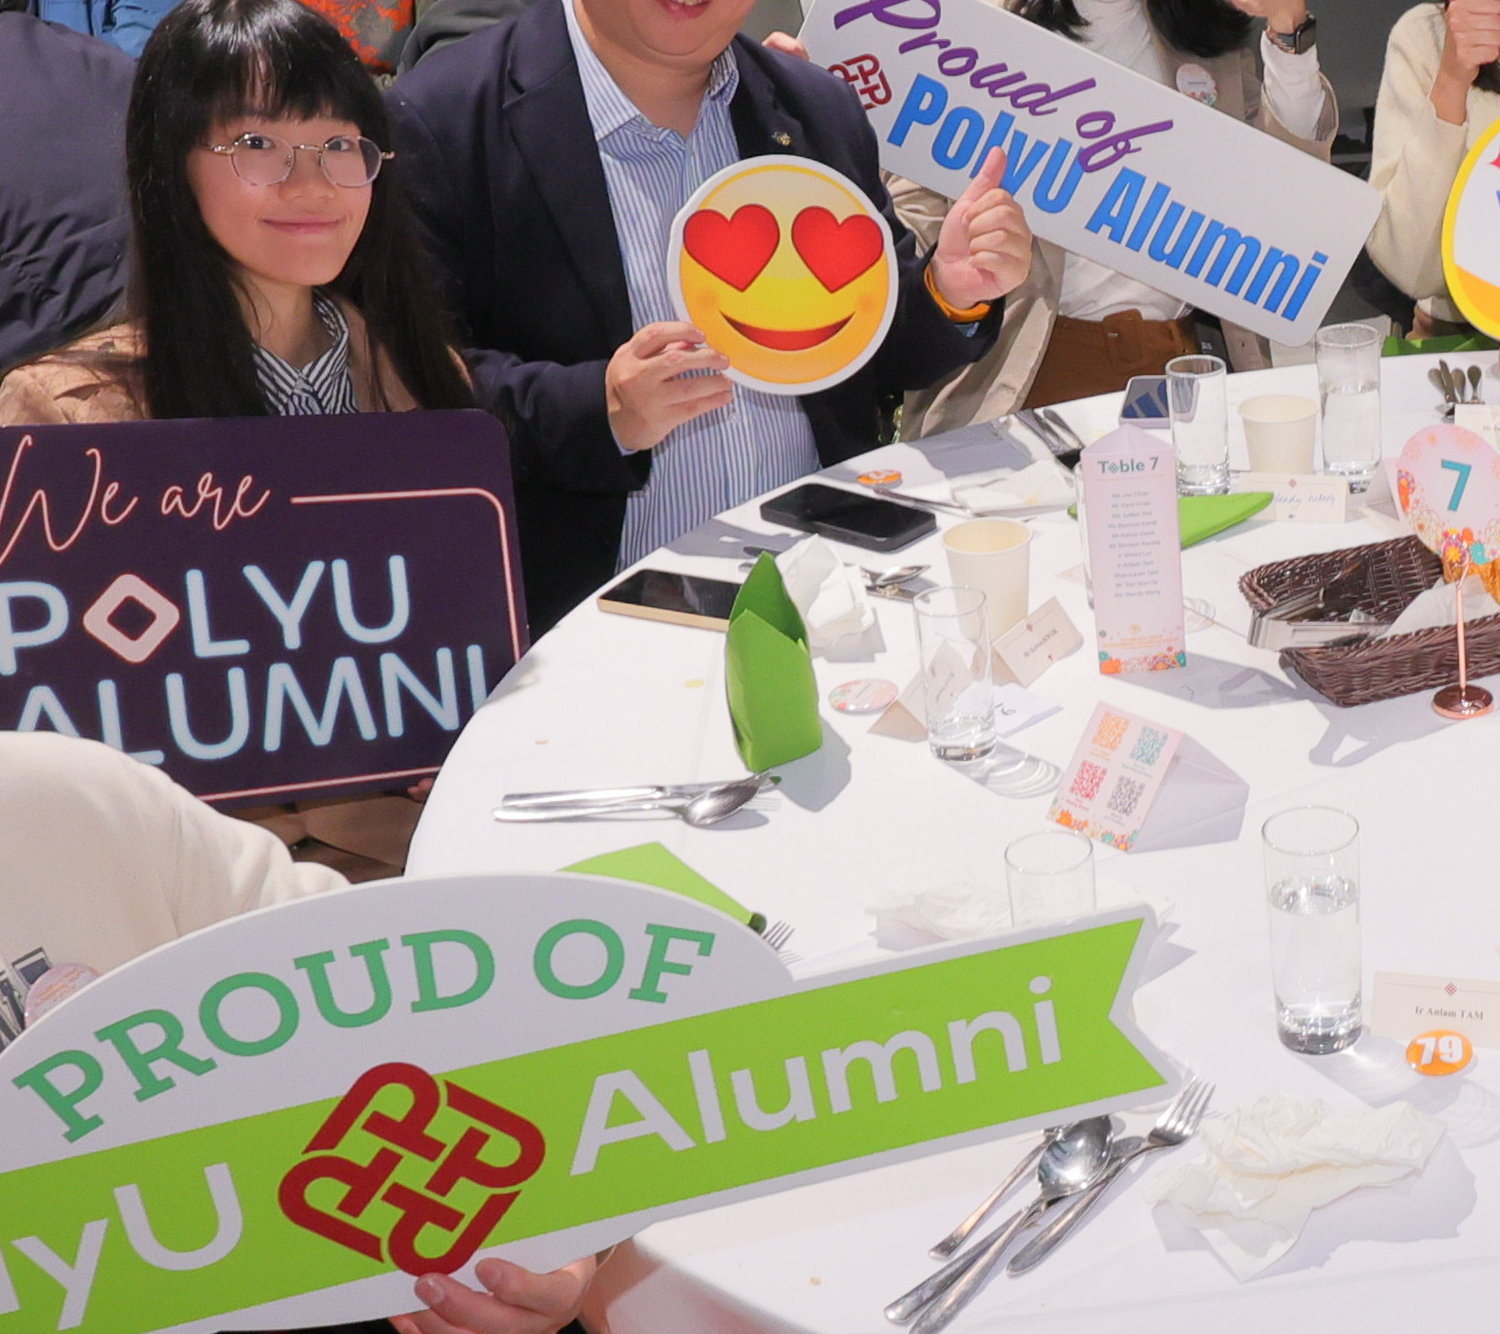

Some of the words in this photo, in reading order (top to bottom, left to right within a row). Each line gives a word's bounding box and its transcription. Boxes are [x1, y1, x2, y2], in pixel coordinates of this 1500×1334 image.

[1075, 118, 1174, 174] of
[887, 73, 1088, 214] PolyU
[1084, 164, 1329, 323] Alumni
[1149, 456, 1160, 470] 7
[1439, 459, 1472, 512] 7
[160, 471, 271, 530] are
[12, 928, 495, 1144] PROUD
[532, 918, 716, 1005] OF
[1460, 1009, 1485, 1021] TAM
[570, 975, 1064, 1177] Alumni
[1416, 1034, 1465, 1065] 79
